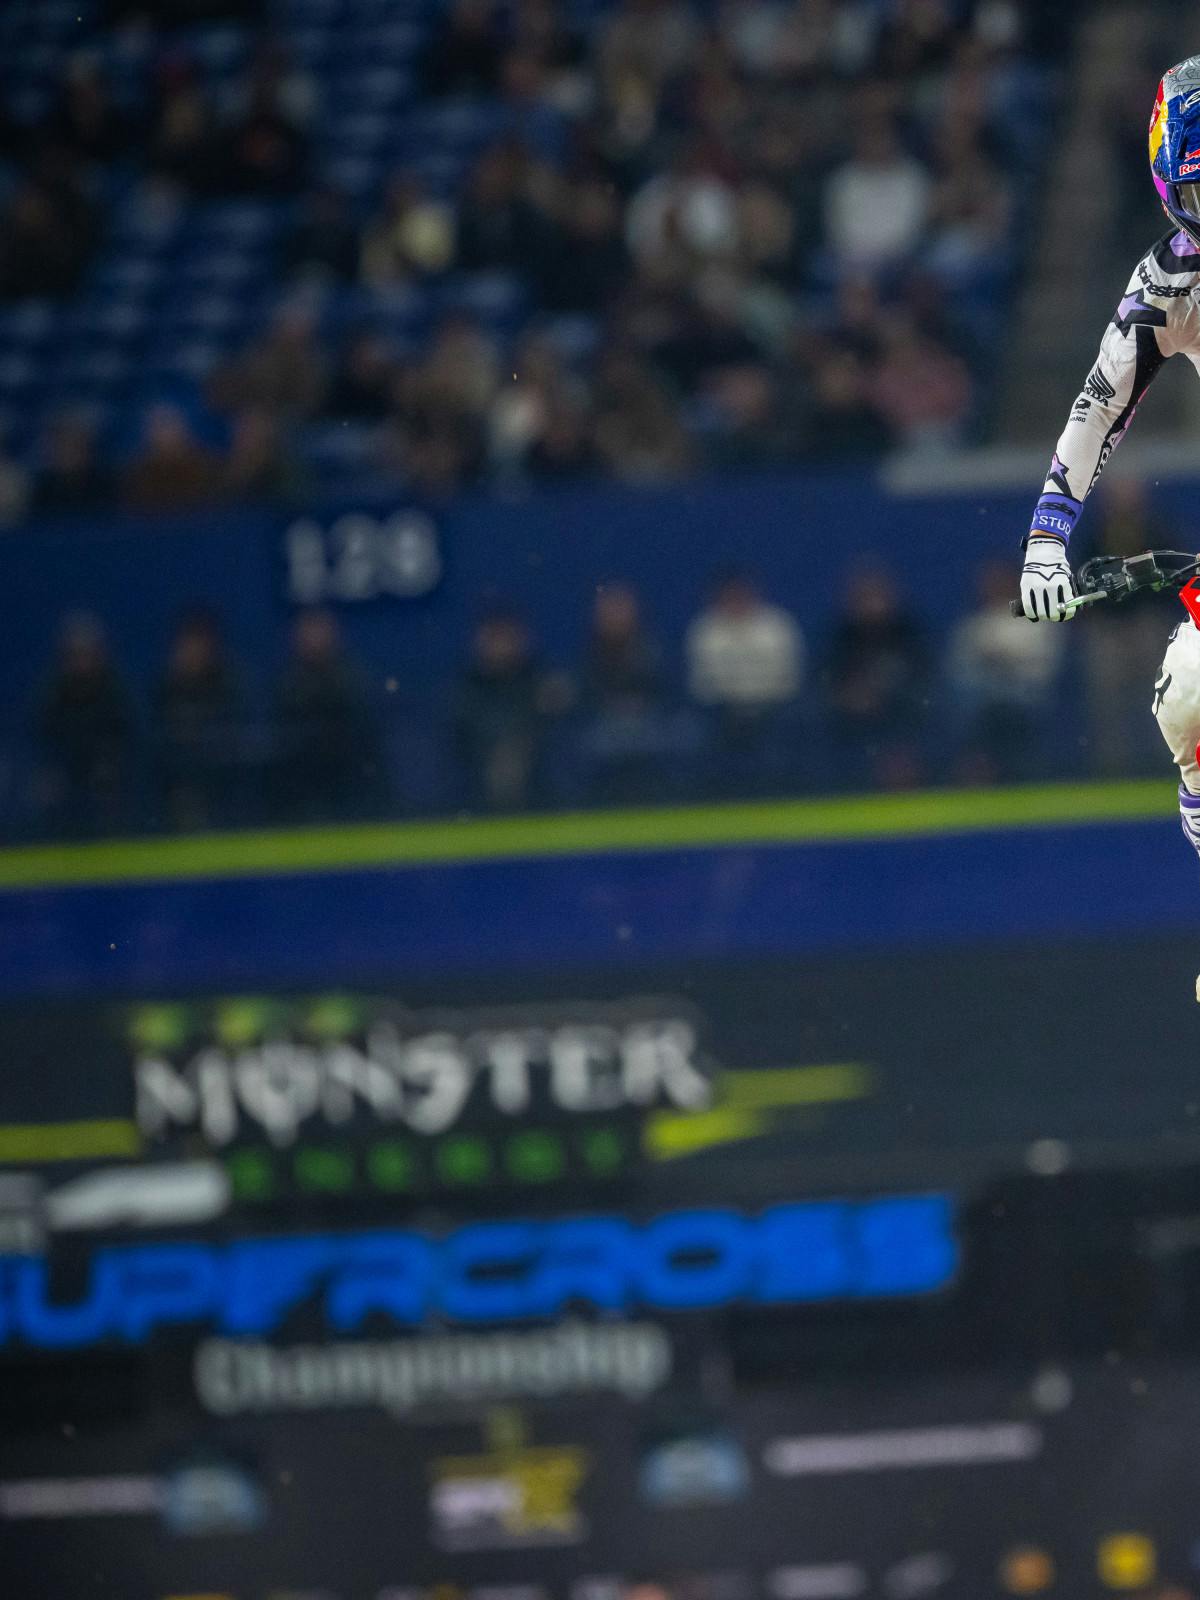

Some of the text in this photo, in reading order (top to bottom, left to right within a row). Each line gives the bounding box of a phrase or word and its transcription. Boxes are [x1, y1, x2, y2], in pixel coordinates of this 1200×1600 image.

[1084, 385, 1109, 407] NDA
[134, 1015, 716, 1145] MONSTER
[0, 1194, 960, 1348] UPERCROSS
